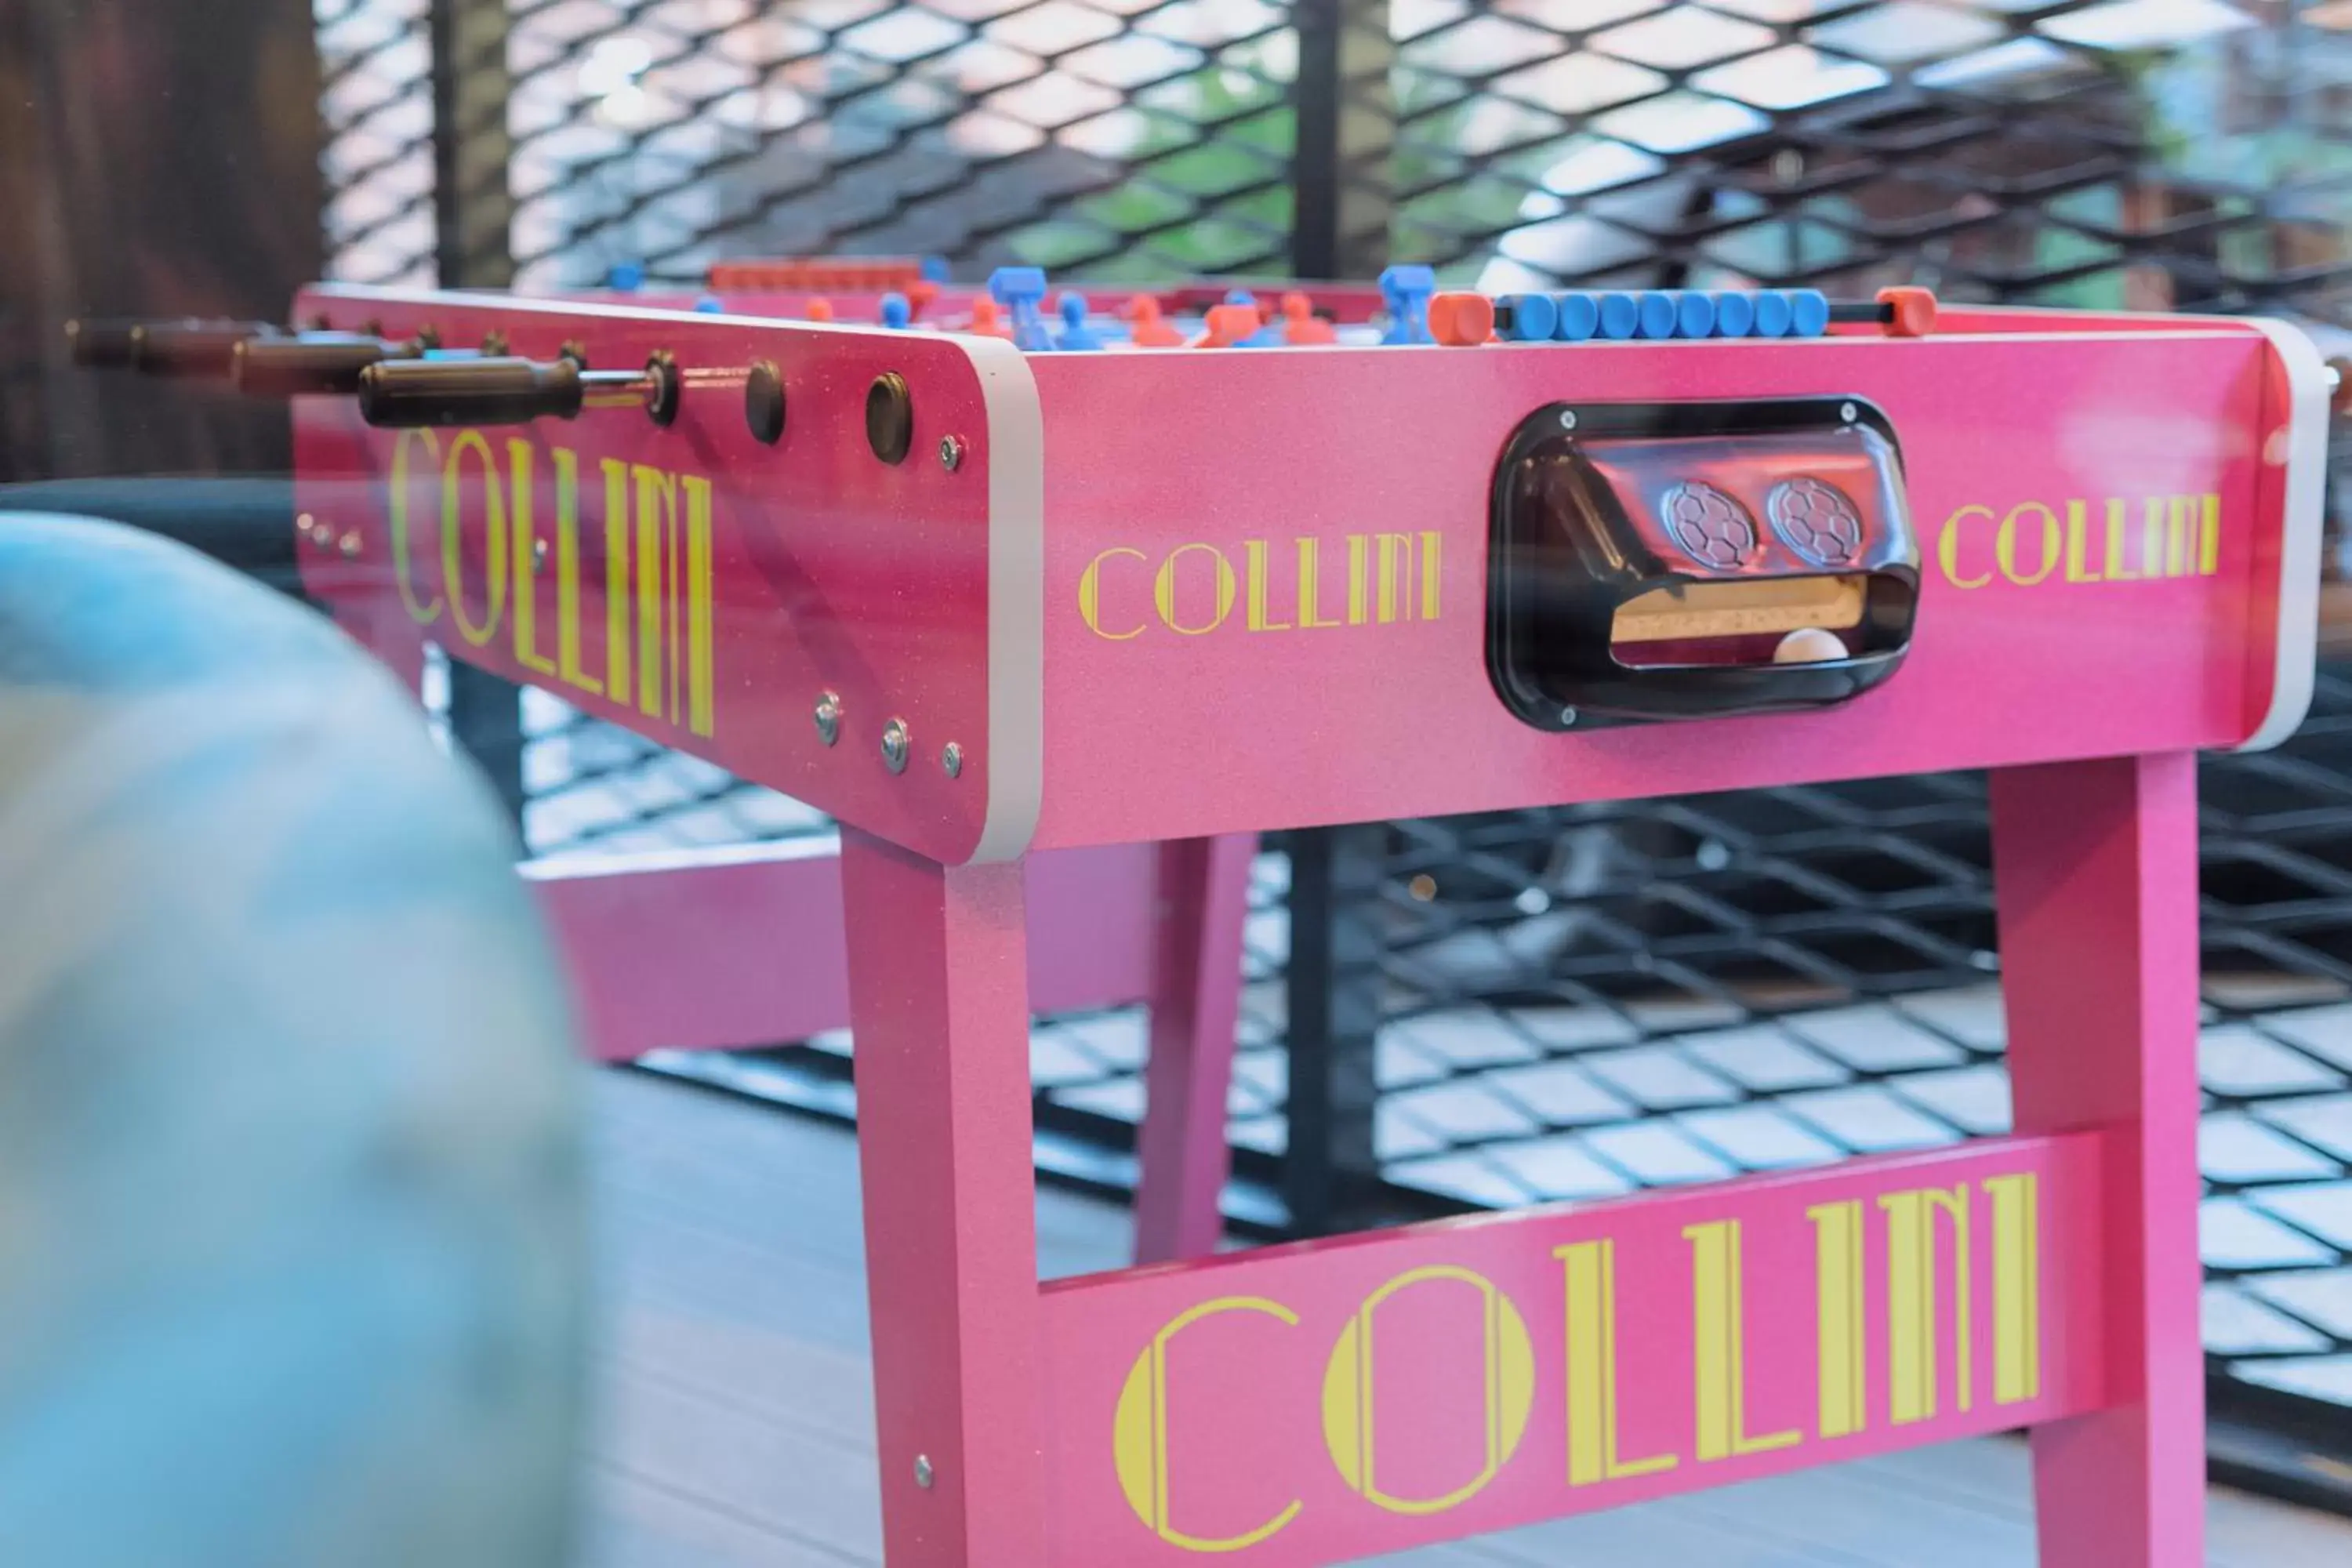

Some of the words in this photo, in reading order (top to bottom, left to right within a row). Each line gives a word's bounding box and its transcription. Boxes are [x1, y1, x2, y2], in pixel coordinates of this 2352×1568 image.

[390, 427, 713, 739] COLLINI
[1078, 531, 1441, 640] COLLINI
[1939, 494, 2220, 589] COLLINI
[1113, 1174, 2038, 1552] COLLINI
